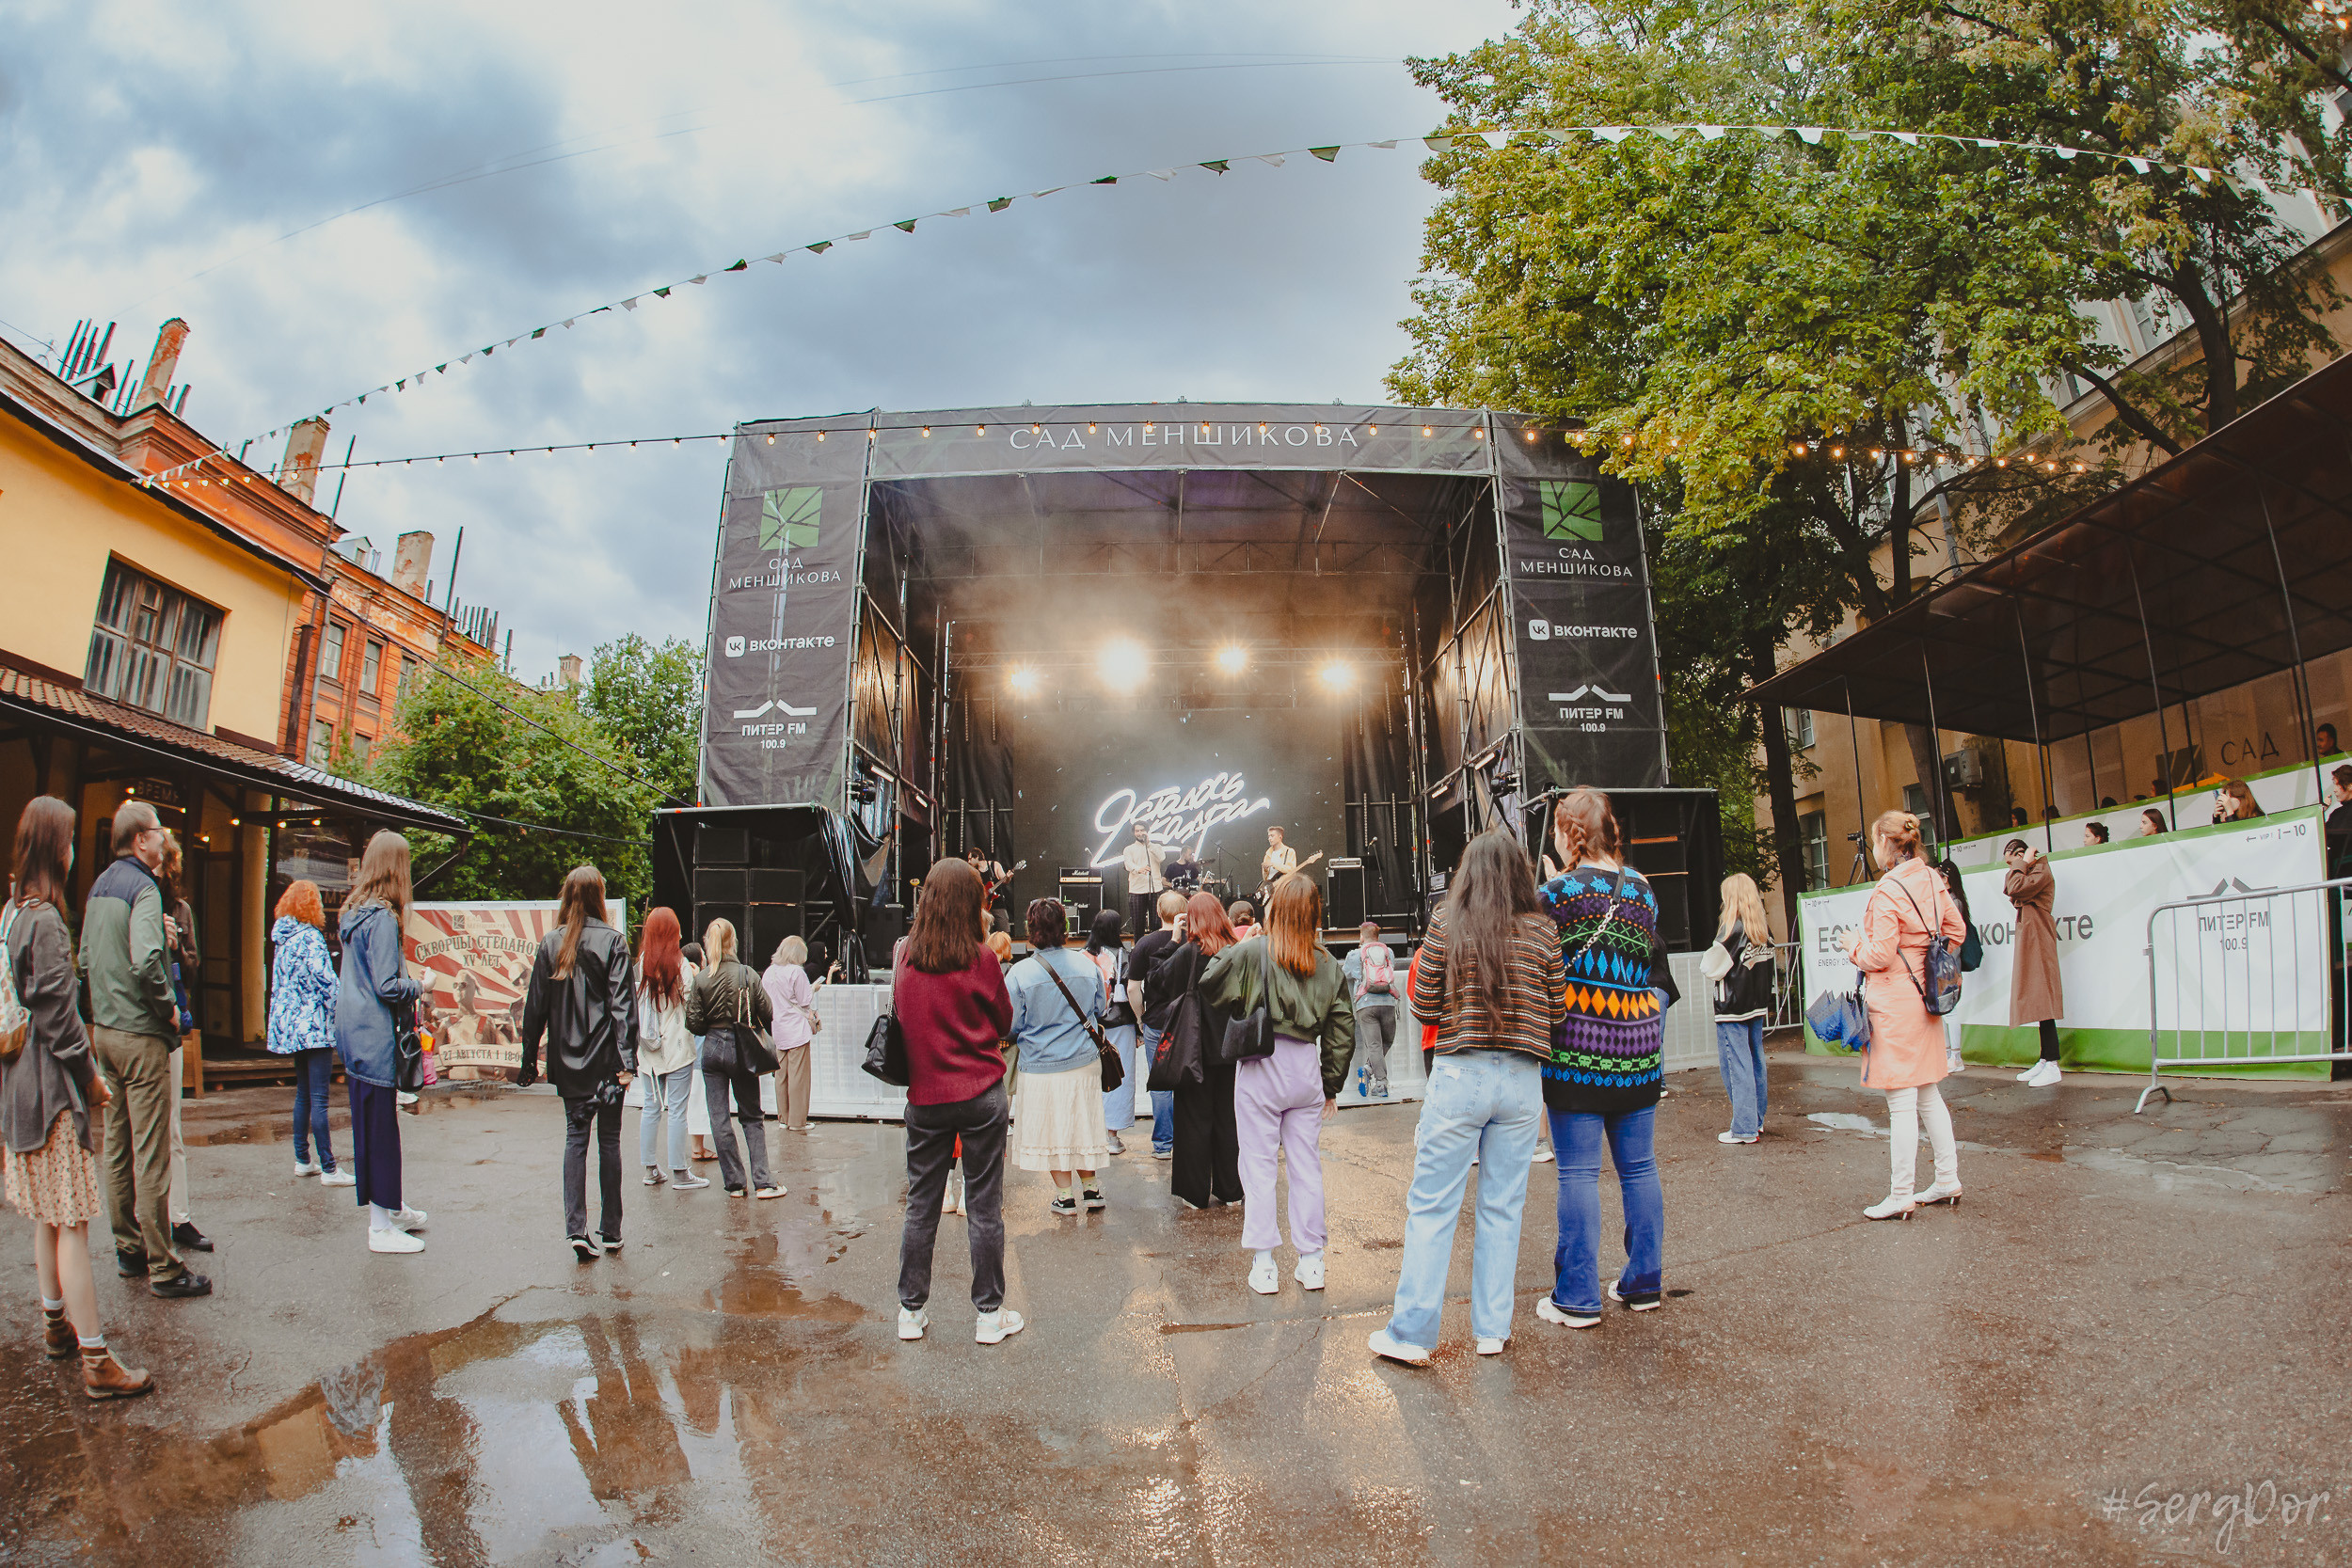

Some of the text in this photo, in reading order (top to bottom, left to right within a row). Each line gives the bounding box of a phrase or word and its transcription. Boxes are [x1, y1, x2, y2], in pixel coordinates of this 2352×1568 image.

[1009, 425, 1359, 451] САД МЕНШИКОВА
[1559, 547, 1595, 561] САД
[769, 557, 803, 570] САД
[1520, 562, 1633, 577] МЕНШИКОВА
[729, 570, 842, 589] МЕНШИКОВА
[1559, 707, 1624, 720] ПИТЕР FM
[741, 722, 806, 736] ПИТЕР FM
[1581, 723, 1606, 733] 100.9
[760, 739, 787, 749] 100.9
[2221, 732, 2280, 766] САД
[2249, 911, 2269, 928] FM
[416, 935, 472, 961] СКВОРЦЫ
[481, 954, 501, 967] ЛЕТ
[1818, 958, 1840, 967] ENERGY
[443, 1051, 452, 1061] 27
[456, 1049, 492, 1060] АВГУСТА
